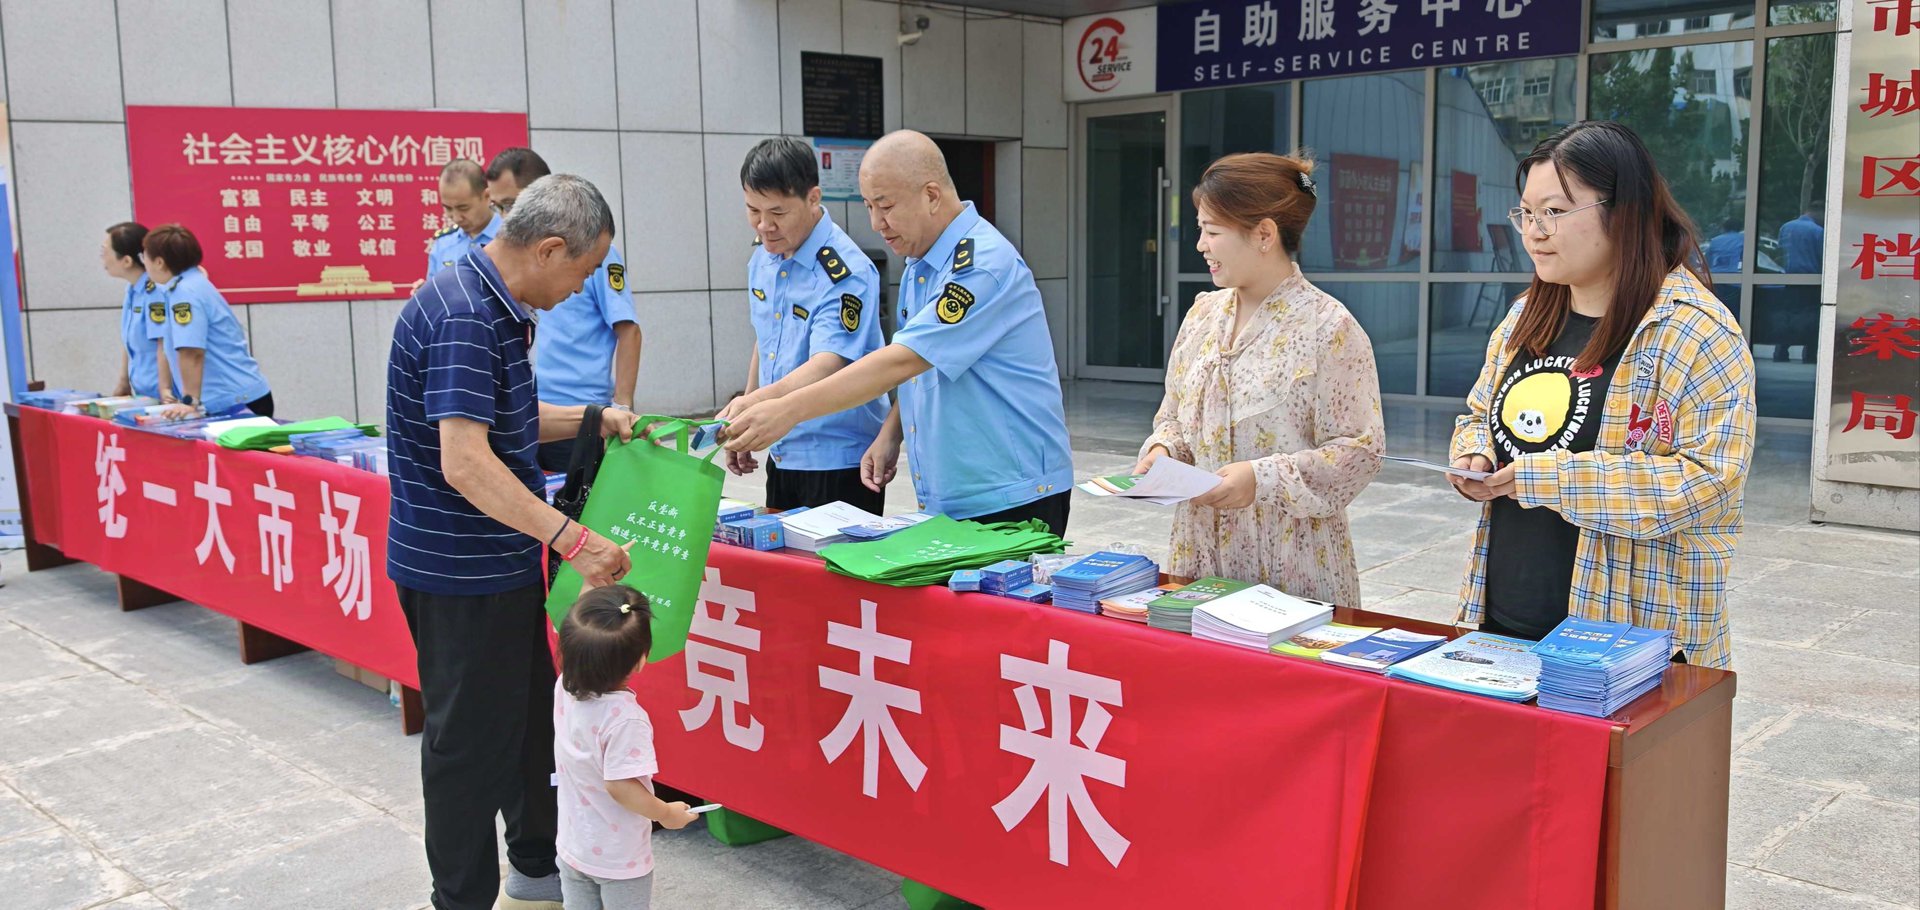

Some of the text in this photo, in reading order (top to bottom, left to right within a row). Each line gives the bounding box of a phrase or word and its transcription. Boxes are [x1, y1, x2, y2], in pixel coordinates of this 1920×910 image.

[1089, 36, 1118, 64] 24
[1194, 32, 1530, 82] SELF-SERVICE CENTRE
[1097, 61, 1131, 74] SERVICE
[182, 133, 485, 166] 社会主义核心价值观
[220, 188, 438, 208] 富强 民主 文明 和
[223, 214, 262, 233] 自由
[291, 213, 329, 232] 平等
[358, 213, 395, 231] 公正
[224, 238, 396, 259] 爱国 敬业 诚信
[1558, 382, 1592, 449] LUCKYMON
[1656, 403, 1670, 441] DETROIT
[647, 501, 679, 519] 反垄断
[94, 430, 372, 621] 统一大市场
[626, 512, 687, 541] 反不正当竞争
[678, 566, 1131, 868] 竞未来
